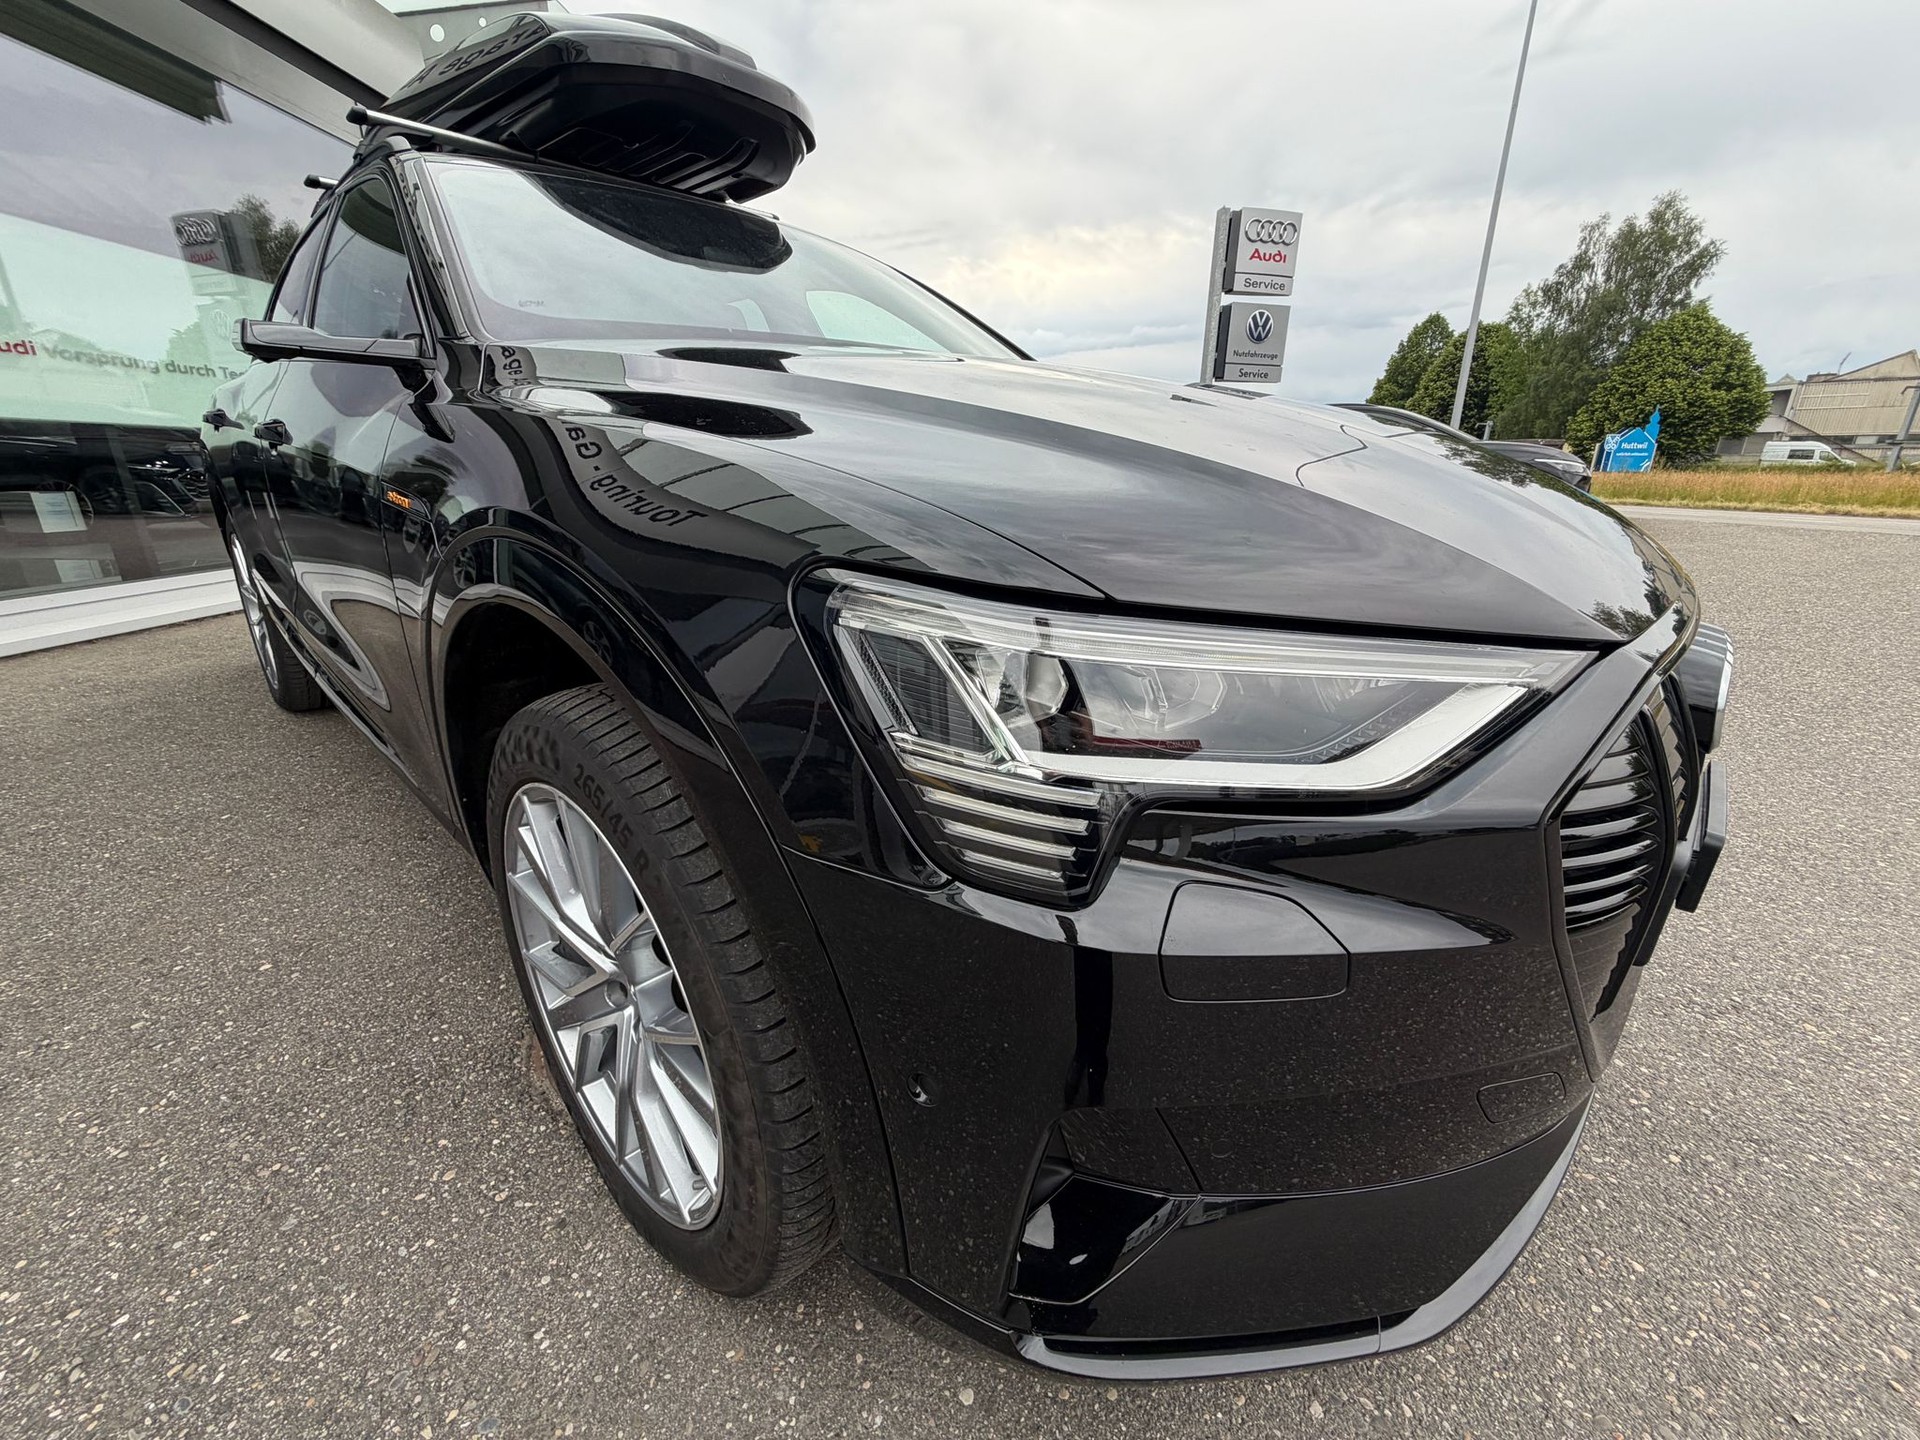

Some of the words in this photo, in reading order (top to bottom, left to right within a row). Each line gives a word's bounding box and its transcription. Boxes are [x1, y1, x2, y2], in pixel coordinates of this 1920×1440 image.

[1249, 248, 1287, 264] Audi
[1243, 277, 1286, 291] Service
[0, 339, 38, 356] udi
[41, 342, 160, 374] Vorsprung
[165, 360, 217, 378] durch
[1233, 349, 1279, 361] Nutzfahrzeuge
[1238, 367, 1269, 379] Service
[1620, 441, 1649, 450] Huttwil
[573, 762, 634, 849] 265/45
